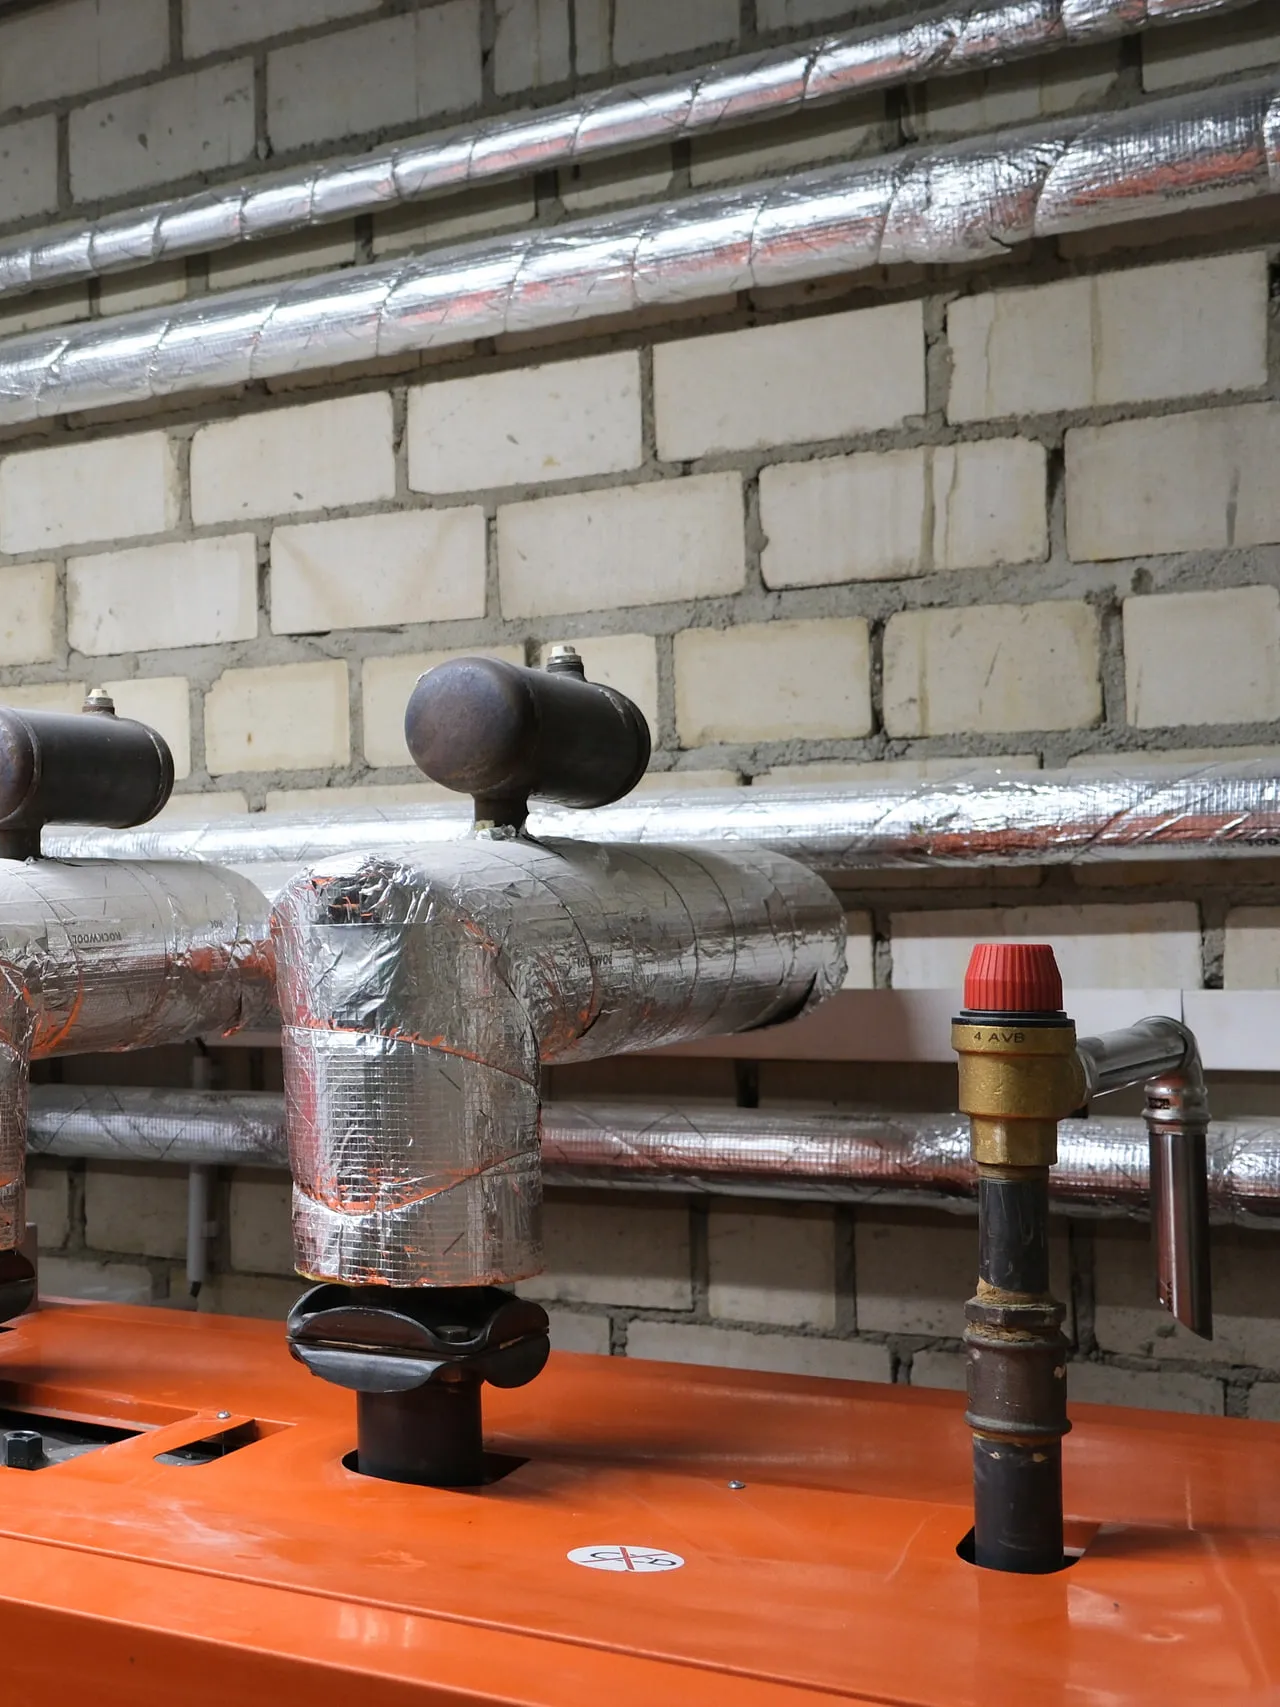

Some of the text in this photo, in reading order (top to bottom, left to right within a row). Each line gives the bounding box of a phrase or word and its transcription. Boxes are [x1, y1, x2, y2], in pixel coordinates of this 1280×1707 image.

[71, 930, 122, 944] ROCKWOOL
[974, 1031, 1025, 1043] 4 AVB
